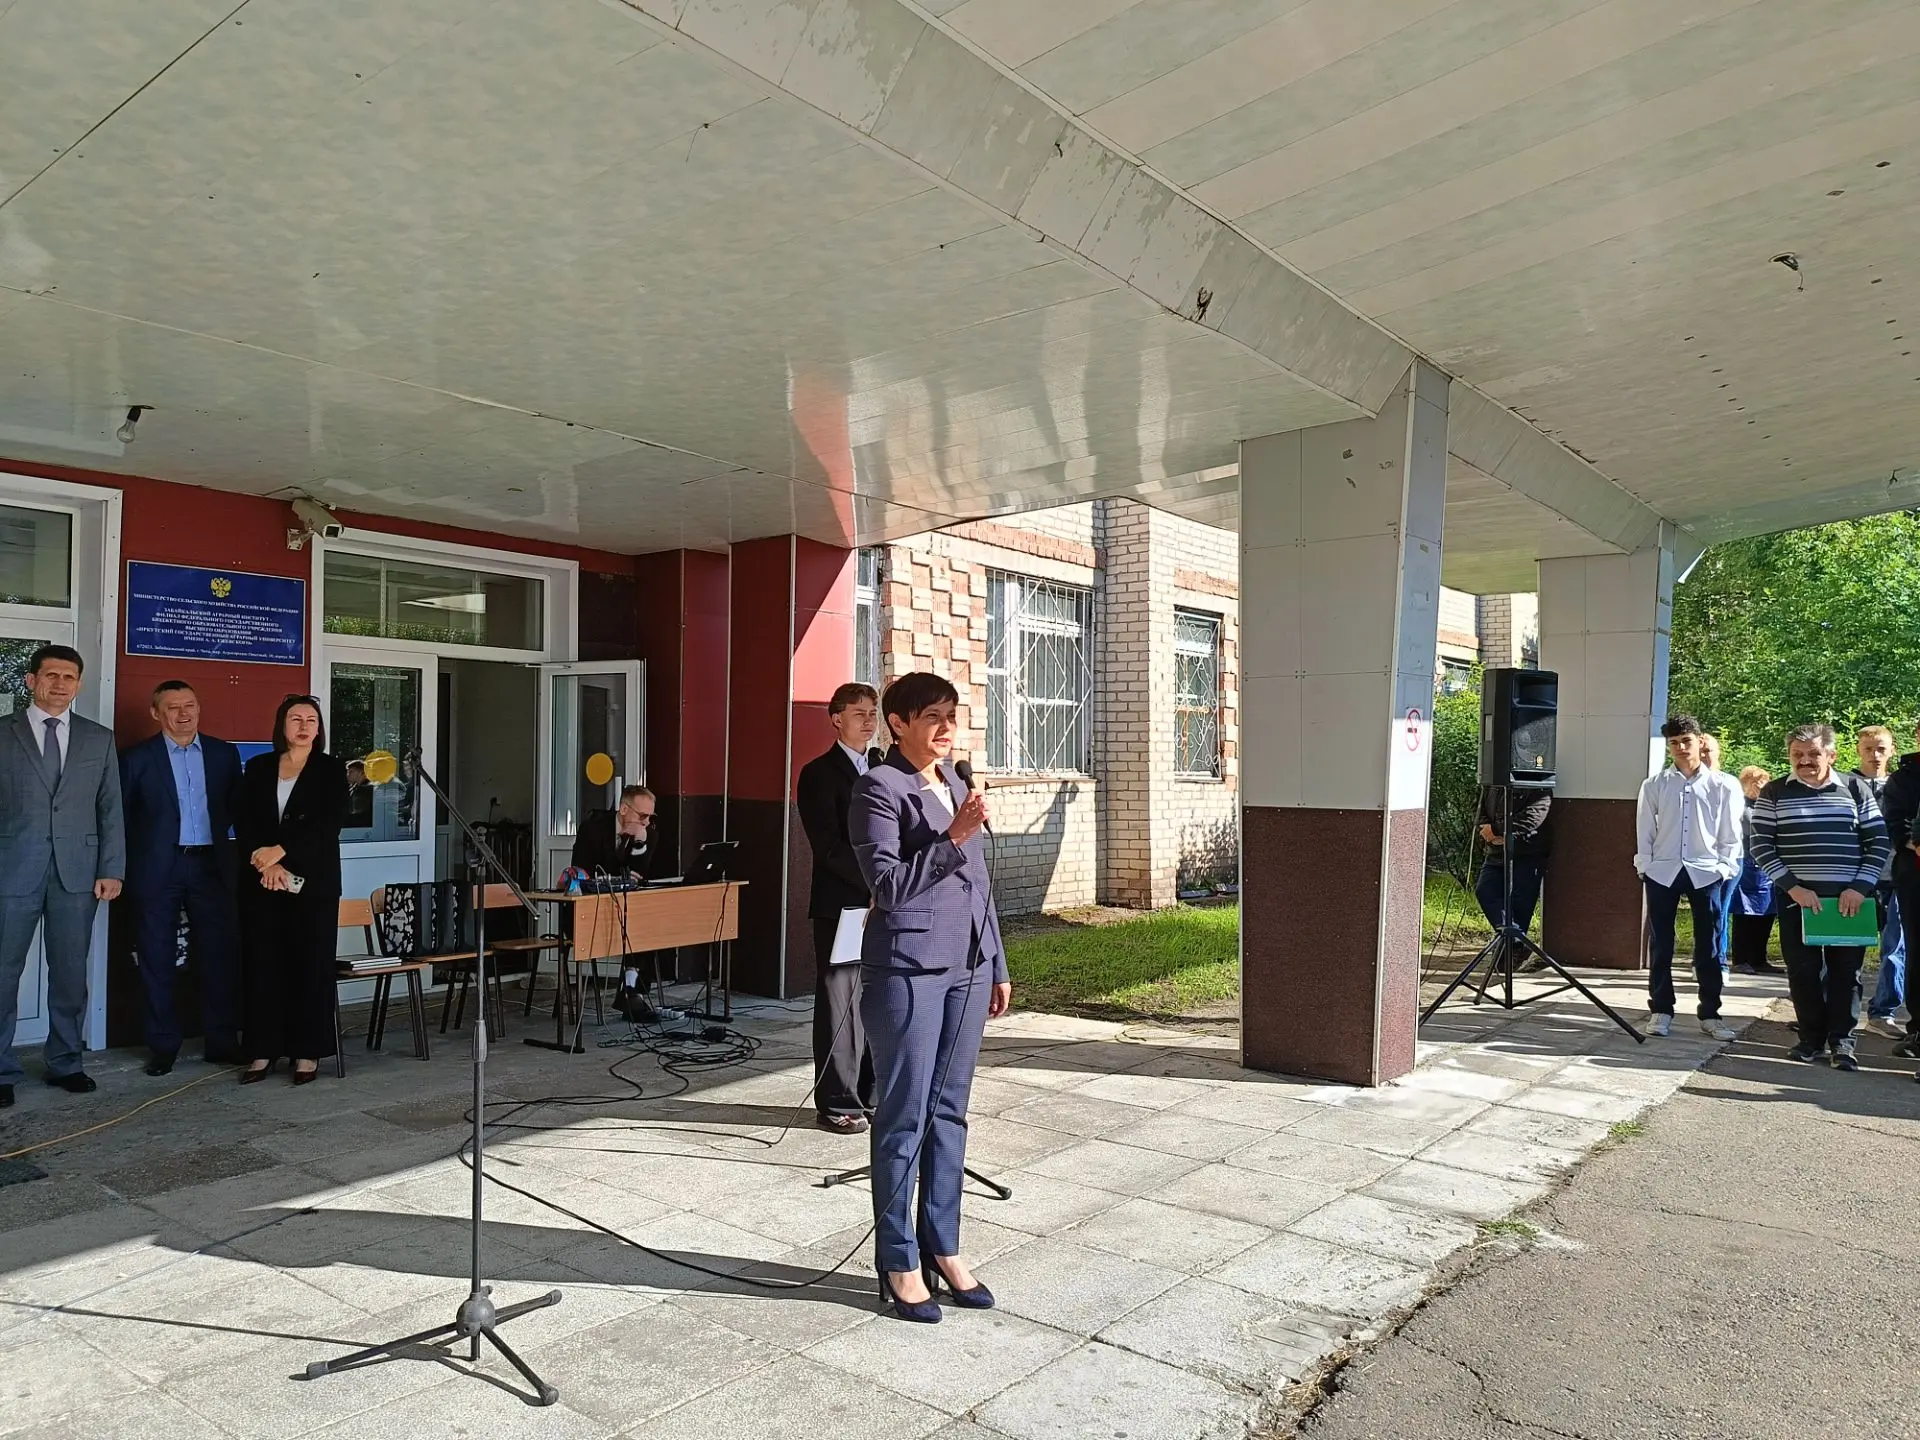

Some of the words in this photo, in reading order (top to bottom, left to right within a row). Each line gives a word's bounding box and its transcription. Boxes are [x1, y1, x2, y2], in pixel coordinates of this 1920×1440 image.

[134, 593, 176, 602] МИНИСТЕРСТВО
[164, 608, 211, 616] ЗАБАЙКАЛЬСКИЙ
[152, 617, 192, 625] БЮДЖЕТНОГО
[192, 621, 246, 629] ОБРАЗОВАТЕЛЬНОГО
[181, 614, 224, 622] ФЕДЕРАЛЬНОГО
[225, 619, 279, 627] ГОСУДАРСТВЕННОГО
[174, 630, 229, 638] ГОСУДАРСТВЕННЫЙ
